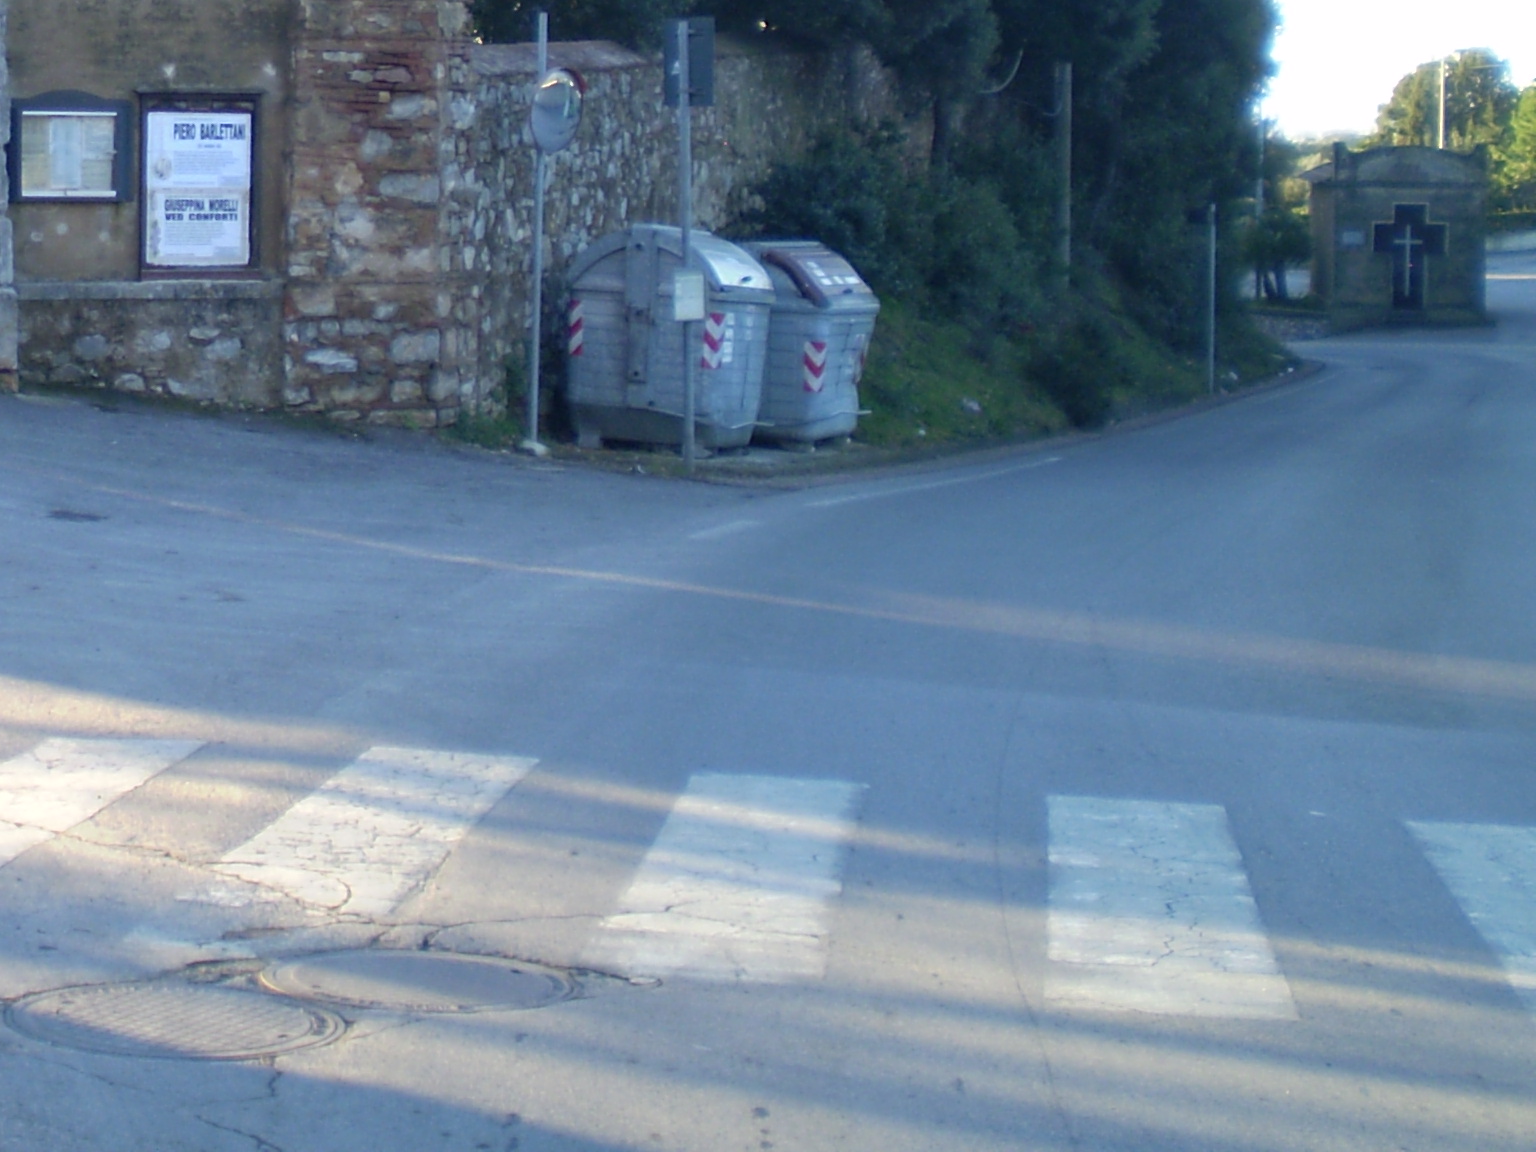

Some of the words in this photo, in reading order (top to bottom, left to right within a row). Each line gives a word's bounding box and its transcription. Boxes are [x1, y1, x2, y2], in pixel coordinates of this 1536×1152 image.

[173, 123, 196, 140] PIERO
[200, 123, 246, 140] BARLETTANI
[164, 199, 205, 212] GIUSEPPINA
[209, 199, 238, 212] MORELLI
[188, 213, 238, 221] CONFORTI
